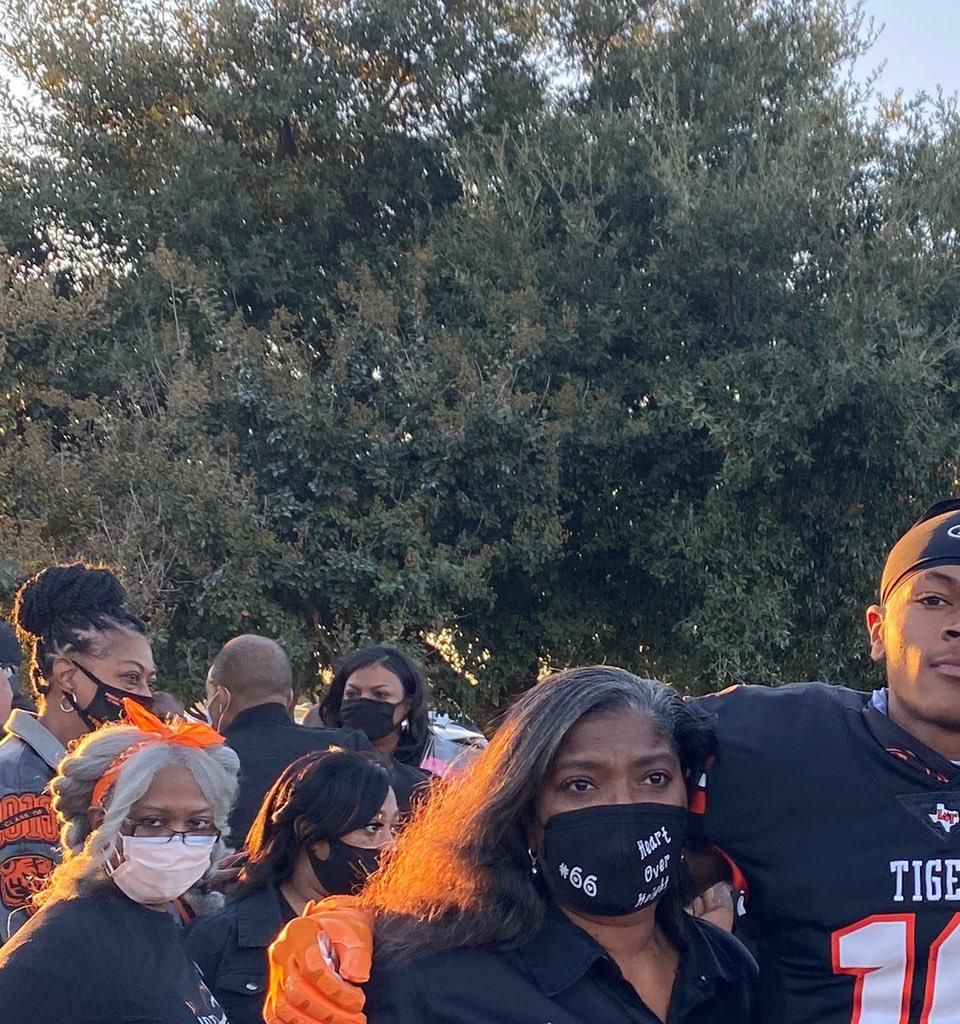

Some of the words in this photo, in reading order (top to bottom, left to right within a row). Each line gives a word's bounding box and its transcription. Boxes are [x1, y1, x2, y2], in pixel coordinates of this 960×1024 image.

[636, 825, 672, 861] Heart
[558, 862, 599, 898] #66
[643, 853, 671, 884] Over
